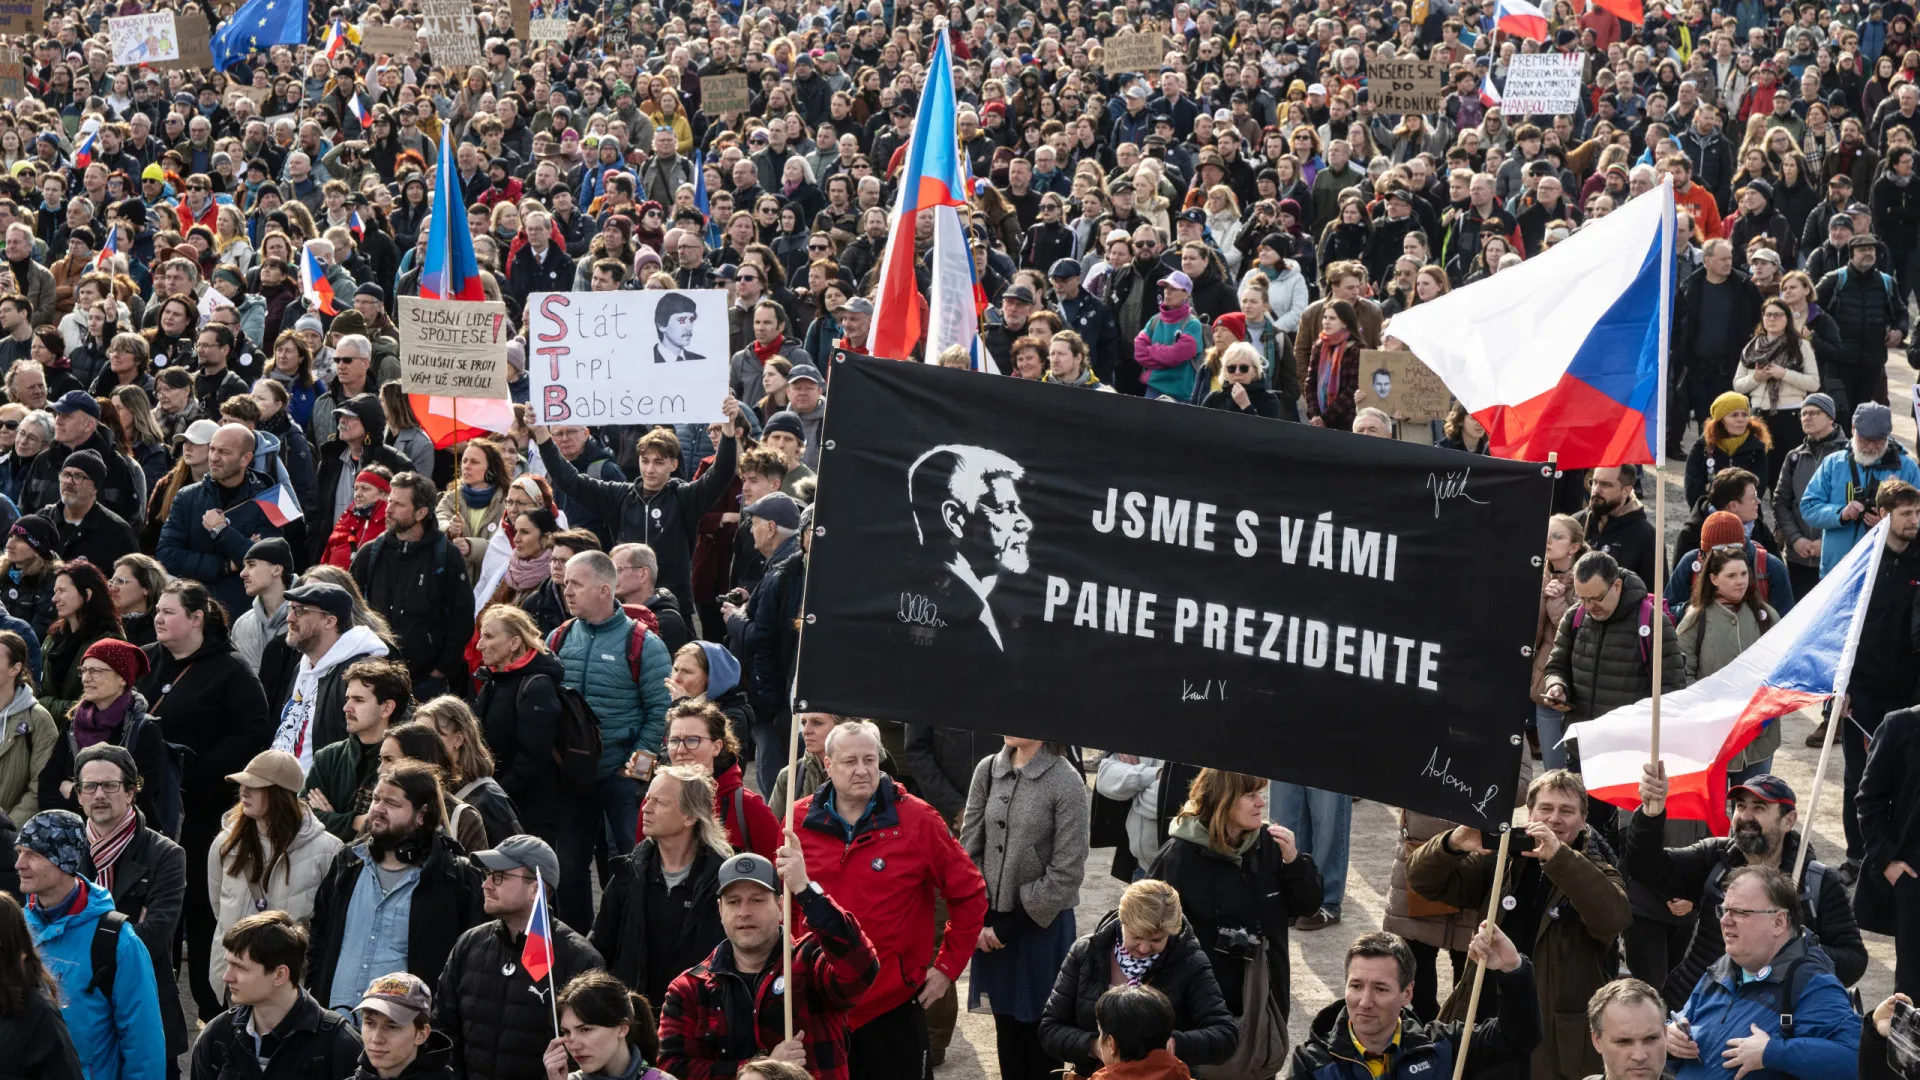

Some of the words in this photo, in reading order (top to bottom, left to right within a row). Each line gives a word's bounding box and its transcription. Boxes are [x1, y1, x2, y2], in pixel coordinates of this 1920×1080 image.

[1417, 63, 1435, 79] SE
[1392, 81, 1414, 91] DO
[411, 308, 462, 326] SLUŠNÍ
[538, 294, 627, 342] Stát
[407, 353, 456, 369] NESLUŠNÍ
[456, 359, 467, 370] SE
[470, 359, 496, 372] PROTI
[536, 347, 615, 382] Trpí
[409, 371, 431, 384] VÁM
[435, 372, 449, 386] UŽ
[543, 385, 686, 423] Babišem
[1091, 487, 1217, 552] JSME
[1233, 509, 1260, 558] S
[1279, 510, 1398, 582] VÁMI
[1043, 574, 1157, 639] PANE
[1173, 596, 1442, 691] PREZIDENTE
